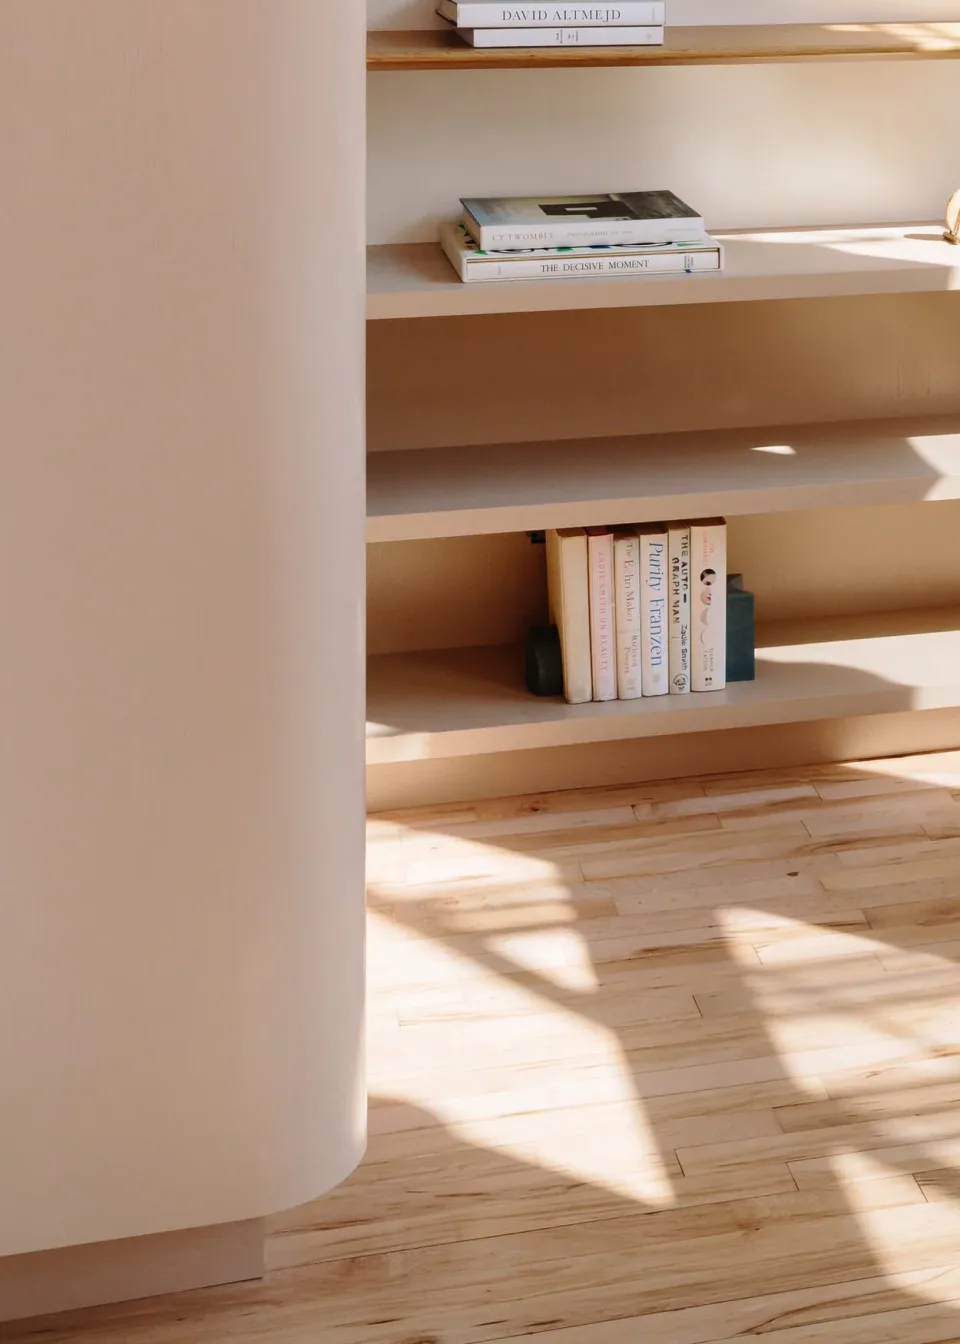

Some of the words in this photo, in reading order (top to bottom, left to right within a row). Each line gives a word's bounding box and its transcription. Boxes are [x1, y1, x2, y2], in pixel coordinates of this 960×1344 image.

[502, 10, 547, 21] DAVID
[552, 10, 621, 23] ALTMEJD
[492, 233, 504, 242] CY
[508, 232, 554, 241] TWOMBLY
[540, 264, 558, 273] THE
[563, 262, 604, 272] DECISIVE
[608, 260, 650, 270] MOMENT
[681, 535, 689, 557] THE
[646, 542, 664, 591] Purity
[672, 557, 680, 595] GRAPH
[598, 583, 607, 615] SMITH
[626, 591, 635, 622] Maker
[672, 600, 680, 624] MAN
[649, 598, 665, 666] Franzen
[600, 634, 609, 671] BEAUTY
